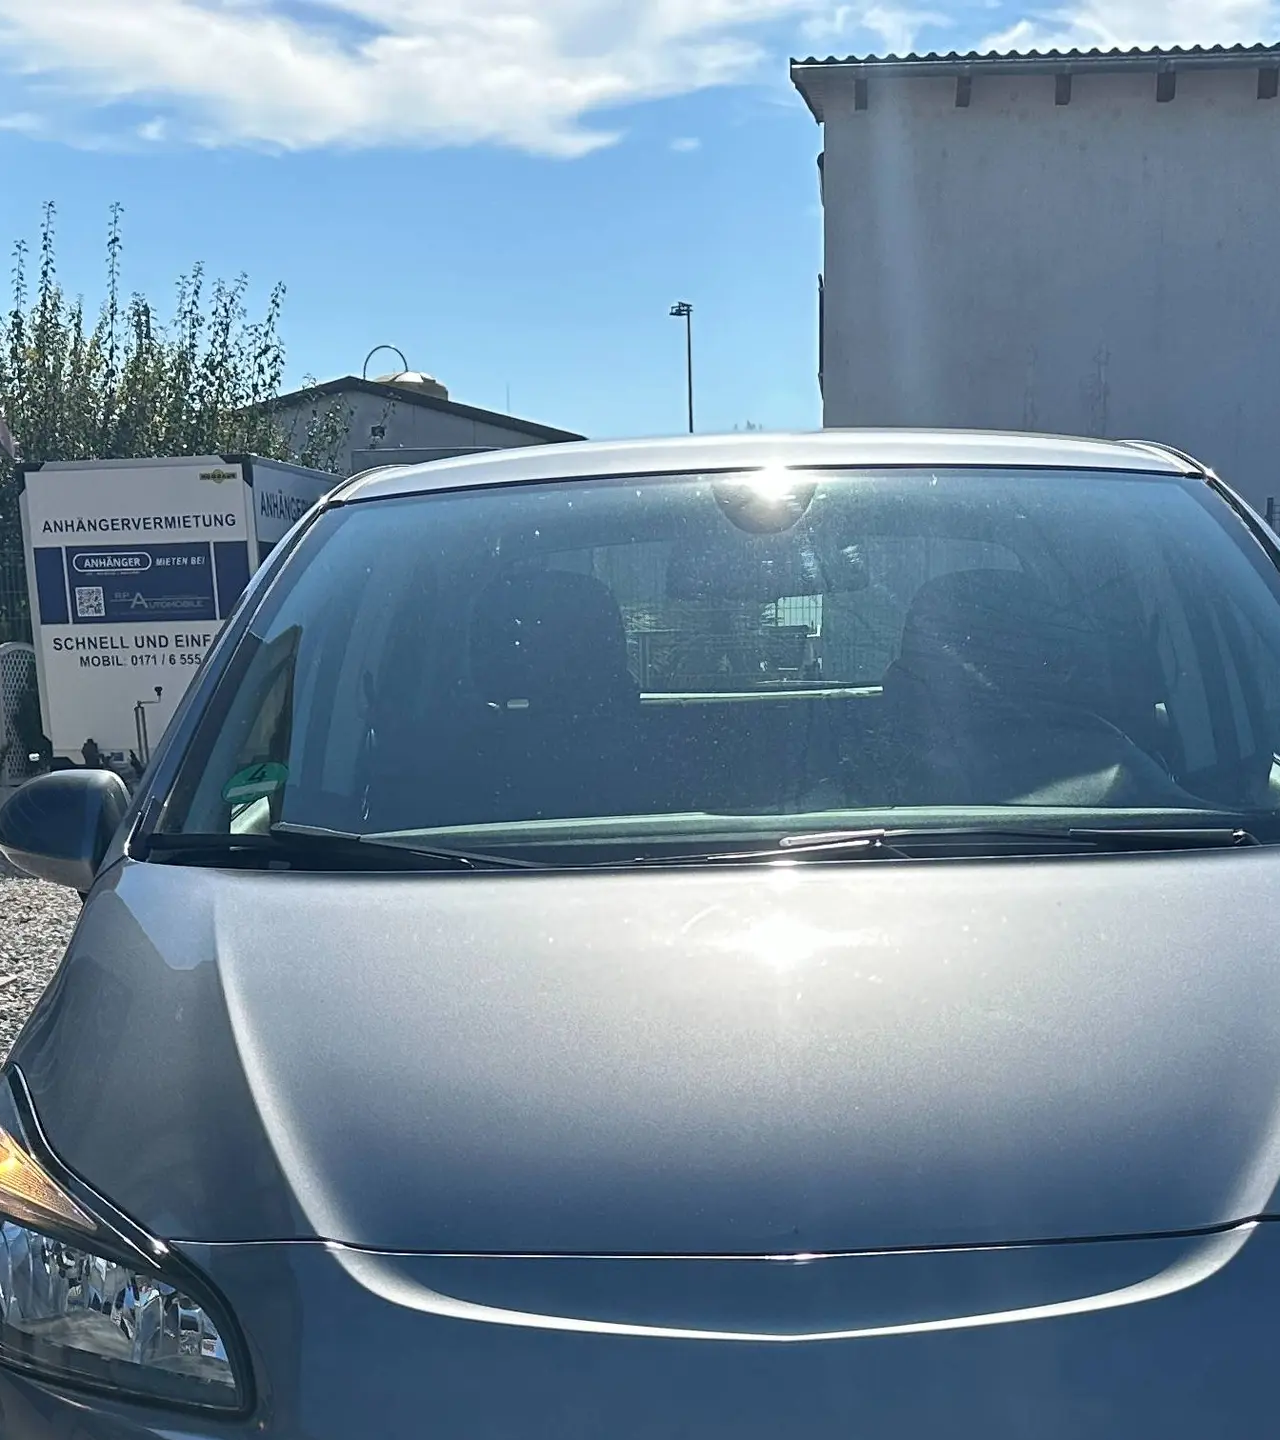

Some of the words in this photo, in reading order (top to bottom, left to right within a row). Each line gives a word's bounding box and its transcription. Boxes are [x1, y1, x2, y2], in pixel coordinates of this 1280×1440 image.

[42, 513, 237, 533] ANHÄNGERVERMIETUNG
[83, 556, 141, 568] ANHÄNGER
[156, 557, 187, 567] MIETEN
[190, 556, 205, 565] BEI
[52, 635, 129, 651] SCHNELL
[134, 634, 169, 649] UND
[174, 633, 217, 649] EINF
[131, 654, 157, 666] 0171
[169, 653, 176, 665] 6
[248, 764, 267, 782] 4
